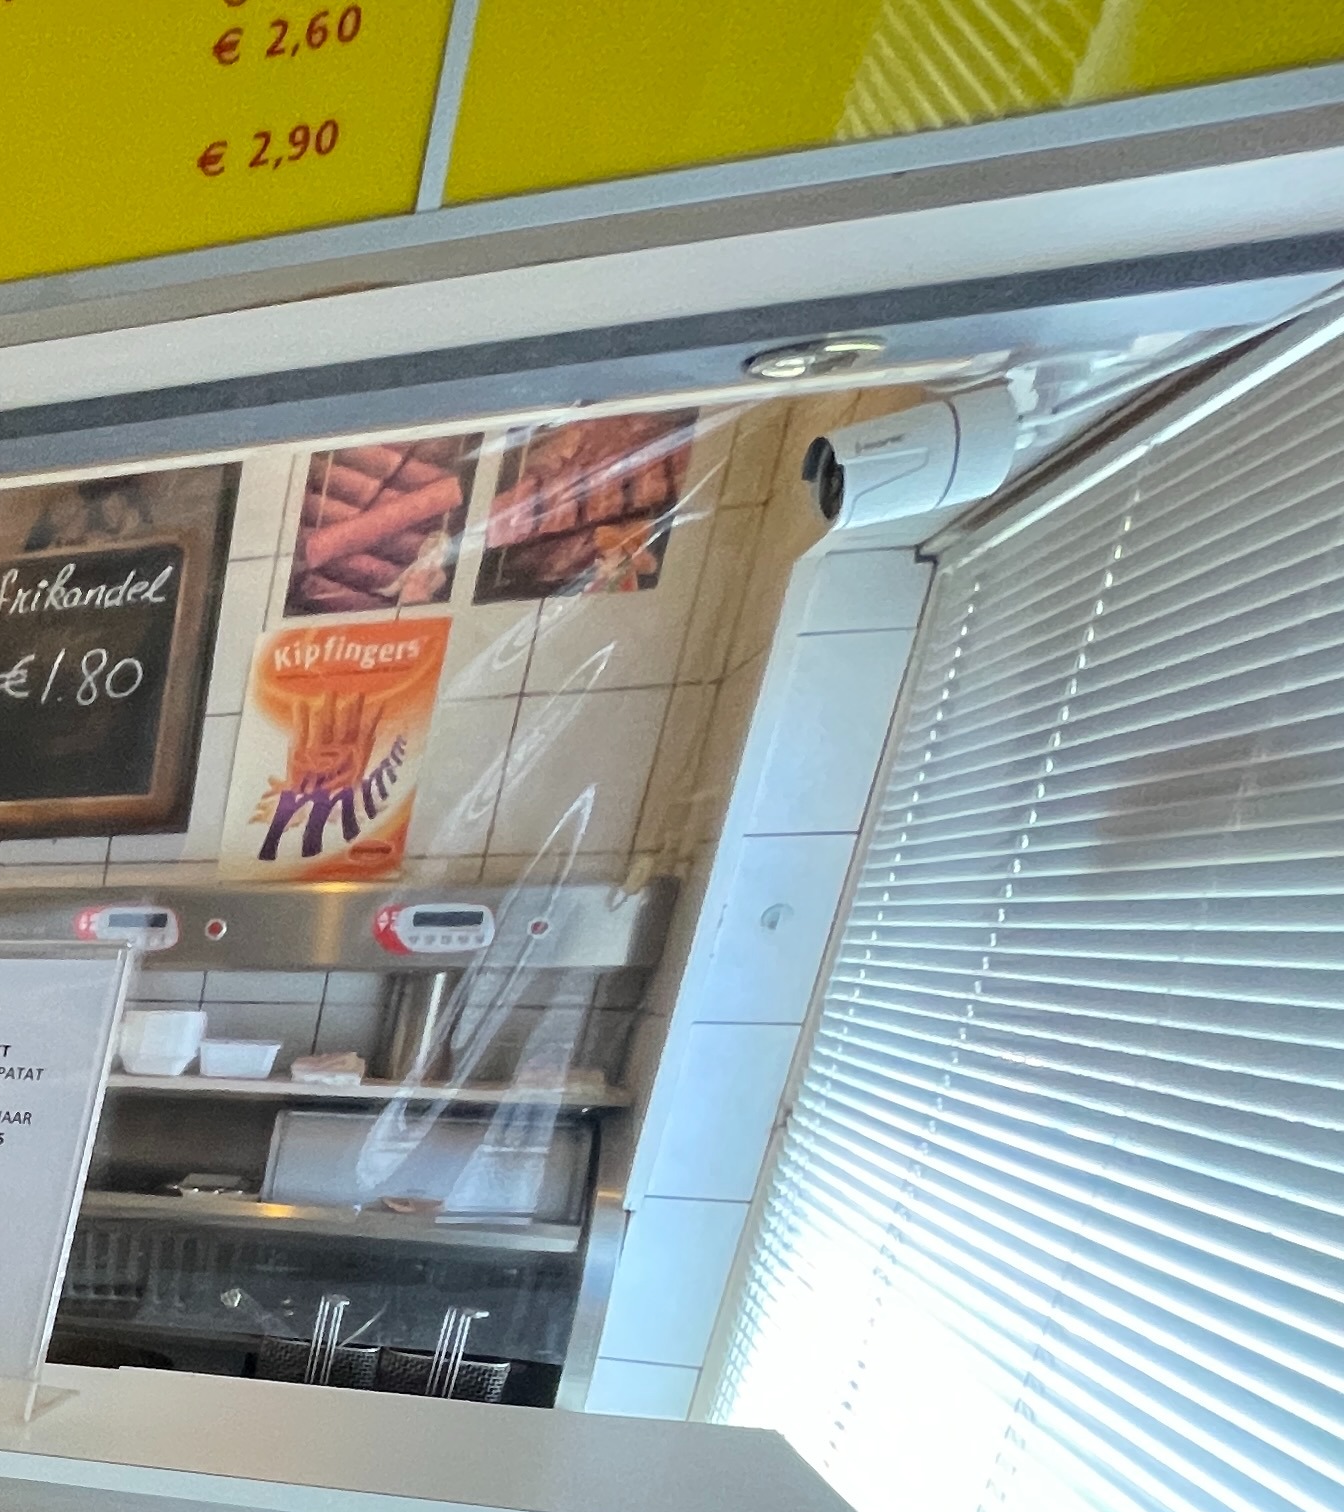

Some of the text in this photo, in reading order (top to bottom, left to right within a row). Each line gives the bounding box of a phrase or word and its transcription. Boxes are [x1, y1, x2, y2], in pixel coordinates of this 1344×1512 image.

[212, 4, 362, 66] € 2,60
[197, 118, 339, 176] € 2,90
[274, 635, 421, 672] Kipfingers
